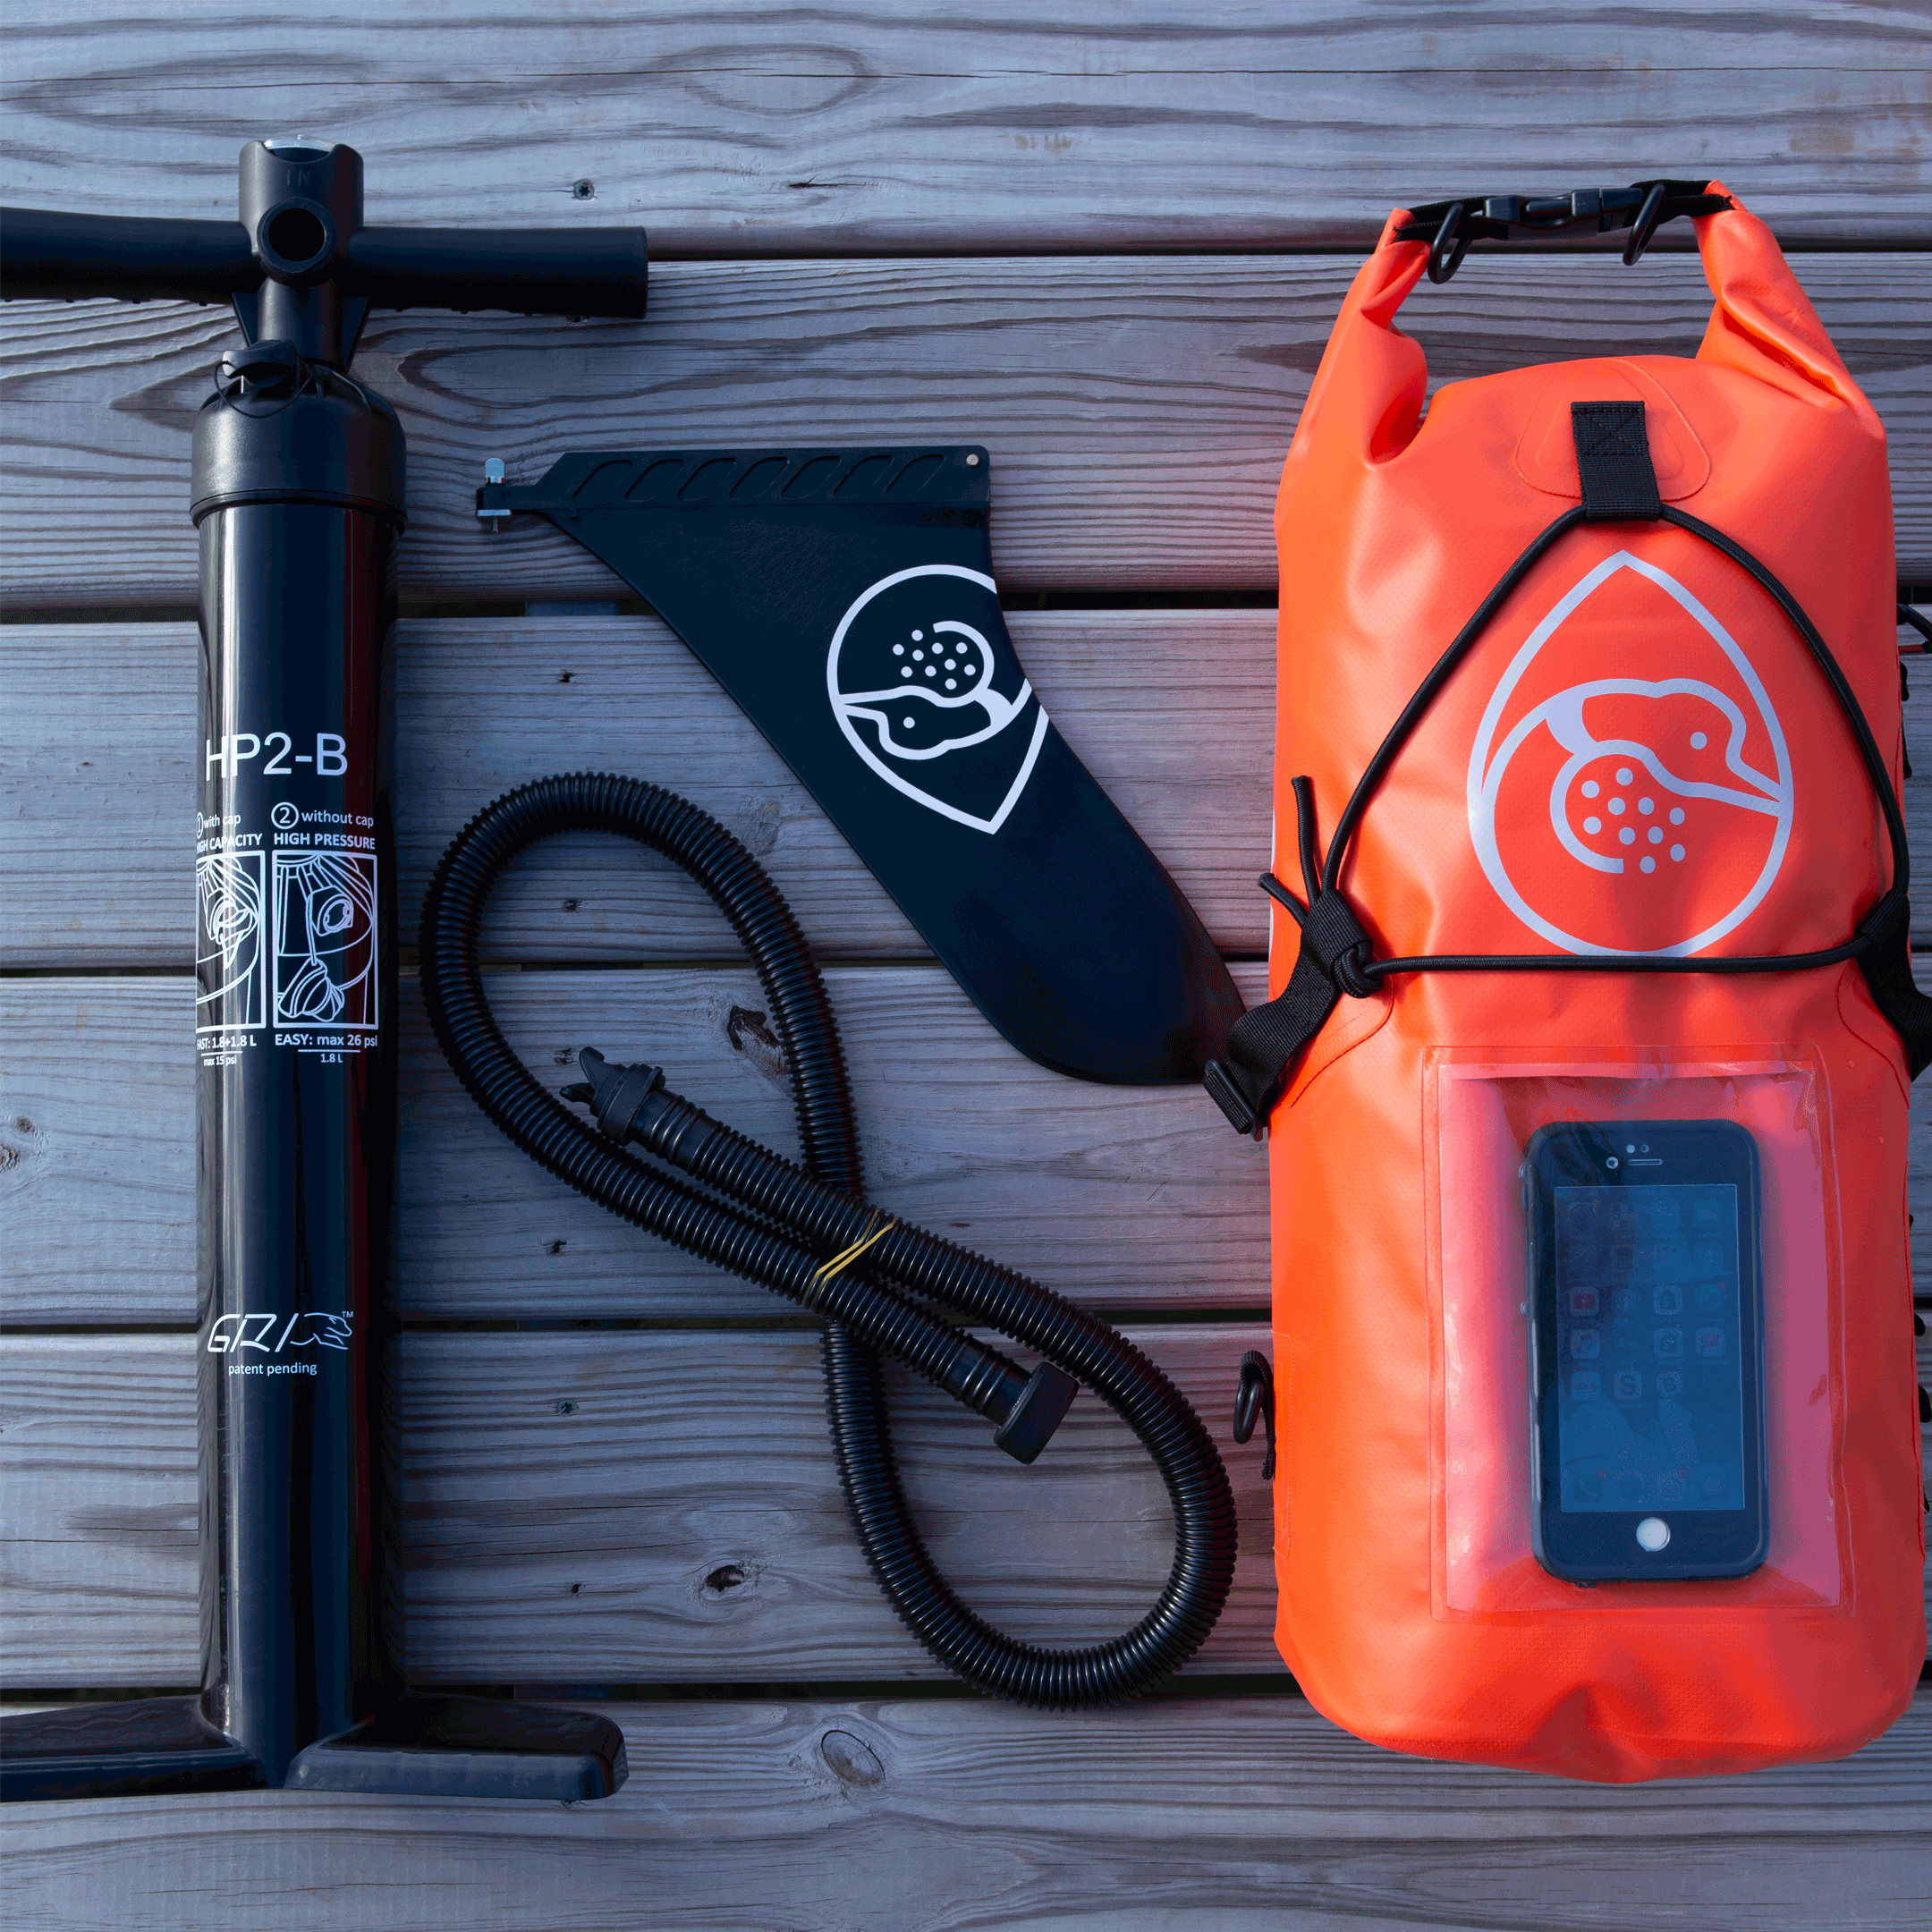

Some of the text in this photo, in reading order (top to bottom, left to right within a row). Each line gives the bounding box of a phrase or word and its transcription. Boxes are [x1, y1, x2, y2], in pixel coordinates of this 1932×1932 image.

[286, 169, 311, 187] IN
[206, 732, 348, 781] HP2-B
[203, 814, 221, 829] with
[223, 814, 242, 827] cap
[301, 809, 352, 825] without
[355, 815, 374, 829] cap
[209, 833, 263, 851] CAPACITY
[274, 832, 376, 850] HIGH PRESSURE
[211, 1034, 248, 1048] 1.8+1.8
[250, 1034, 258, 1046] L
[275, 1033, 377, 1048] EASY: max 26 psi
[203, 1055, 237, 1067] max 15 psi
[320, 1053, 343, 1063] 1.8 L
[228, 1362, 318, 1377] patent pending
